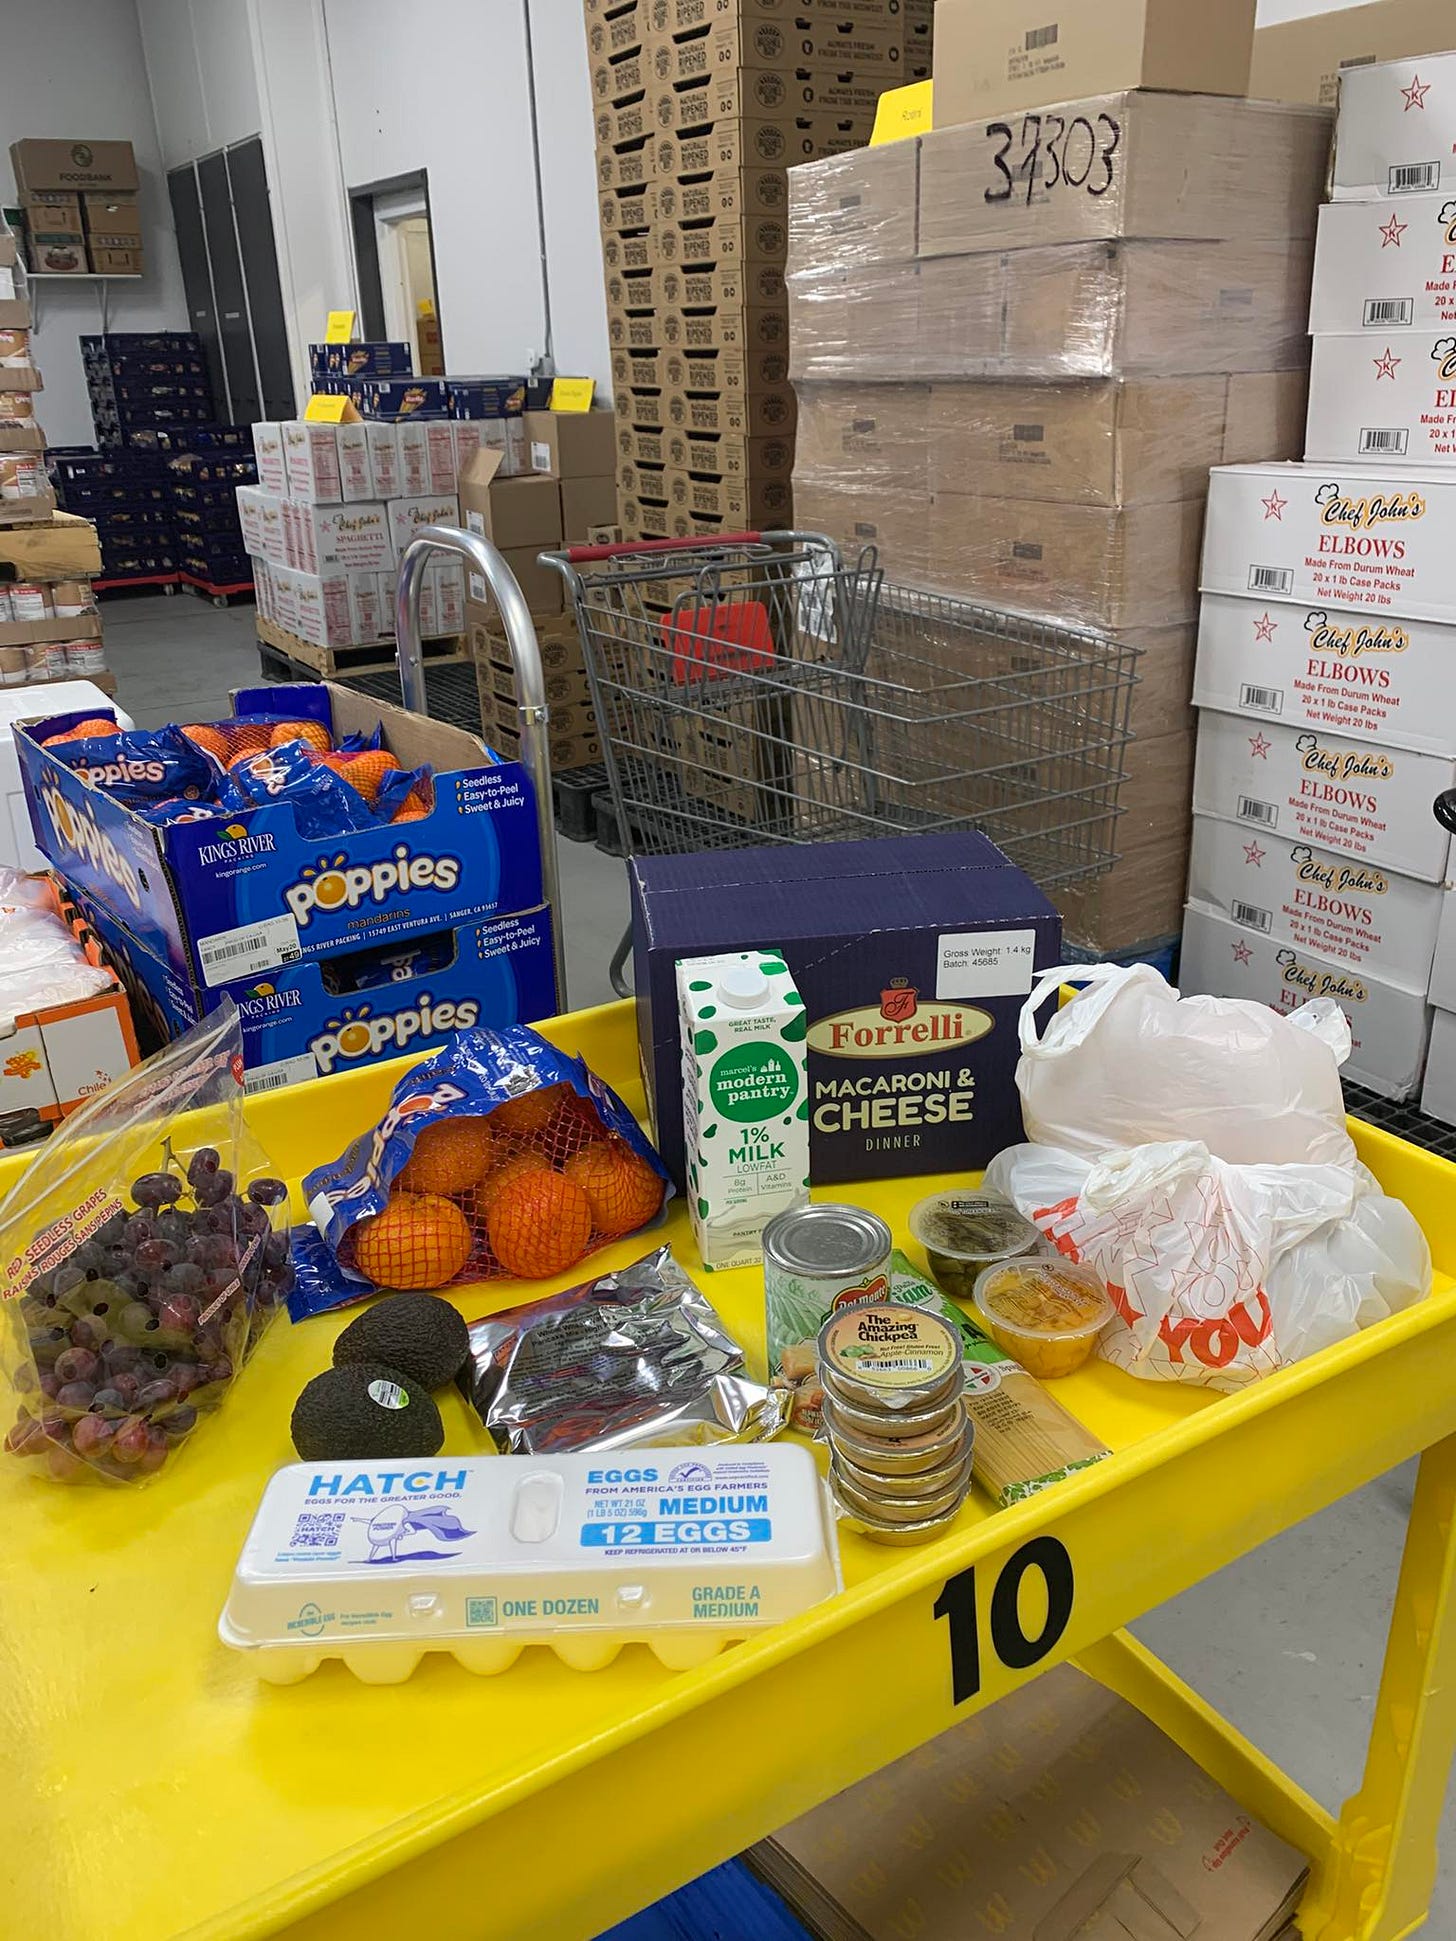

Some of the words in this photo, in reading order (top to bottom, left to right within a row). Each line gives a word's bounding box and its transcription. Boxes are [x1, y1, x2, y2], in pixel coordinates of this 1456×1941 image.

[1324, 500, 1364, 528] Chef
[1366, 495, 1422, 527] John's
[1318, 535, 1405, 559] ELBOWS
[1305, 557, 1327, 569] Made
[1329, 560, 1351, 572] From
[1354, 562, 1384, 575] Durum
[1386, 565, 1415, 577] Wheat
[1313, 572, 1322, 582] 20
[1339, 575, 1348, 585] lb
[1350, 577, 1371, 588] Case
[1374, 579, 1401, 591] Packs
[1317, 587, 1332, 598] Net
[1333, 589, 1363, 602] Weight
[1365, 593, 1376, 603] 20
[1378, 595, 1391, 605] lbs
[1312, 628, 1351, 654] Chef
[1353, 629, 1404, 654] John's
[1307, 658, 1390, 688] ELBOWS
[1294, 679, 1315, 690] Made
[1317, 683, 1339, 696] From
[1341, 687, 1369, 701] Durum
[1371, 692, 1400, 706] Wheat
[1304, 751, 1339, 777] Chef
[1341, 755, 1390, 778] John's
[463, 774, 502, 789] Seedless
[463, 783, 519, 802] Easy-to-Peel
[1300, 778, 1377, 813] ELBOWS
[464, 801, 493, 814] Sweet
[493, 799, 501, 808] &
[502, 796, 525, 809] Juicy
[198, 840, 238, 866] KINGS
[238, 833, 276, 855] RIVER
[215, 863, 267, 878] kingorange.com
[1299, 863, 1335, 889] Chef
[1338, 869, 1385, 892] John's
[284, 846, 459, 926] poppies
[1294, 888, 1373, 926] ELBOWS
[347, 909, 411, 930] mandarins
[482, 919, 519, 935] Seedless
[316, 940, 334, 951] RIVER
[335, 933, 361, 946] PACKING
[368, 927, 387, 938] 15749
[387, 924, 401, 934] EAST
[402, 919, 429, 931] VENTURA
[483, 925, 535, 948] Easy-to-Peel
[484, 945, 510, 960] Sweet
[511, 941, 518, 950] &
[519, 936, 541, 949] Juicy
[943, 949, 969, 959] Gross
[1006, 945, 1019, 955] 1.4
[1021, 945, 1031, 956] kg
[972, 957, 999, 967] 45685
[1284, 966, 1318, 992] Chef
[1319, 975, 1364, 1000] John's
[266, 989, 302, 1011] RIVER
[243, 1017, 293, 1033] kingorange.com
[728, 1018, 752, 1027] GREAT
[734, 1025, 752, 1034] REAL
[754, 1024, 771, 1032] MILK
[828, 1013, 964, 1049] Forrelli
[310, 996, 479, 1073] poppies
[720, 1065, 757, 1076] marcel's
[78, 1078, 107, 1096] Chile
[717, 1073, 787, 1092] modern
[815, 1070, 951, 1099] MACARONI
[957, 1068, 975, 1088] &
[728, 1084, 790, 1107] pantry
[813, 1091, 974, 1133] CHEESE
[740, 1126, 769, 1145] 1%
[865, 1134, 921, 1151] DINNER
[729, 1142, 785, 1164] MILK
[737, 1160, 777, 1174] LOWFAT
[760, 1182, 792, 1191] Vitamins
[766, 1173, 786, 1182] A&D
[6, 1257, 23, 1280] RED
[25, 1217, 73, 1261] SEEDLESS
[73, 1188, 107, 1221] GRAPES
[3, 1267, 39, 1299] RAISINS
[41, 1239, 76, 1272] ROUGES
[75, 1219, 98, 1244] SANS
[716, 1261, 730, 1270] ONE
[731, 1259, 752, 1268] QUART
[858, 1322, 917, 1334] Amazing
[866, 1314, 891, 1325] The
[858, 1331, 918, 1343] Chickpea
[308, 1470, 468, 1496] HATCH
[587, 1468, 659, 1484] EGGS
[585, 1486, 620, 1495] FROM
[622, 1485, 685, 1494] AMERICA'S
[687, 1484, 712, 1492] EGG
[715, 1482, 768, 1491] FARMERS
[334, 1497, 356, 1505] FOR
[359, 1496, 378, 1504] THE
[380, 1493, 426, 1503] GREATER
[594, 1500, 608, 1508] NET
[611, 1500, 622, 1508] WT
[623, 1499, 634, 1508] 21
[636, 1499, 646, 1508] OZ
[659, 1495, 768, 1516] MEDIUM
[595, 1509, 606, 1518] LB
[601, 1524, 642, 1544] 12
[654, 1520, 751, 1543] EGGS
[605, 1548, 623, 1556] KEEP
[624, 1547, 677, 1556] REFRIGERATED
[690, 1546, 701, 1554] OR
[702, 1546, 728, 1554] BELOW
[692, 1586, 745, 1602] GRADE
[749, 1585, 761, 1600] A
[502, 1601, 537, 1617] ONE
[543, 1598, 599, 1616] DOZEN
[693, 1603, 759, 1618] MEDIUM
[933, 1536, 1075, 1706] 10
